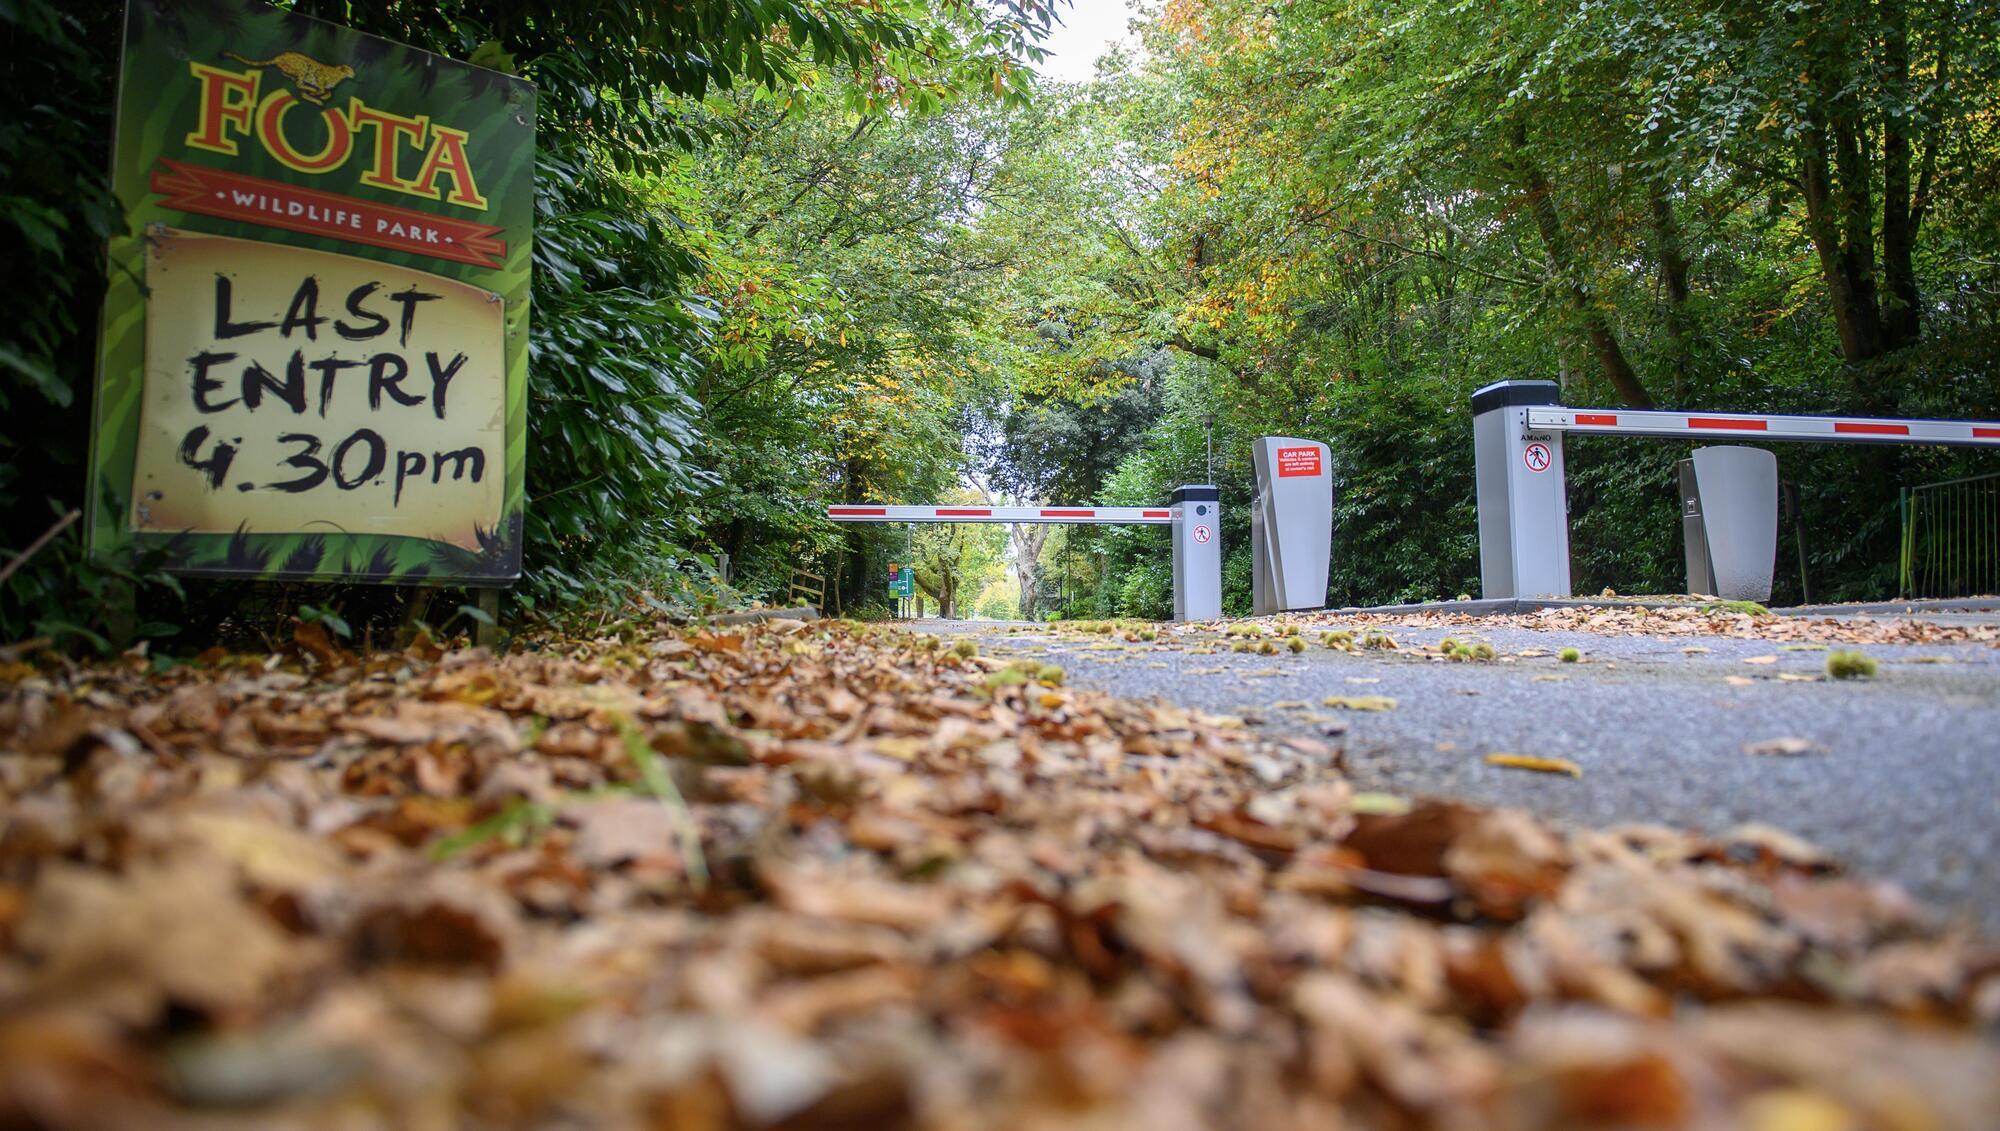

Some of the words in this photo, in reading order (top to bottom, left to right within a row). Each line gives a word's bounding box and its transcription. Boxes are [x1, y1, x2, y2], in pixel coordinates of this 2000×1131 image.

[186, 62, 488, 210] FOTA
[232, 190, 363, 229] WILDLIFE
[376, 219, 439, 244] PARK
[214, 273, 445, 348] LAST
[187, 351, 468, 419] ENTRY
